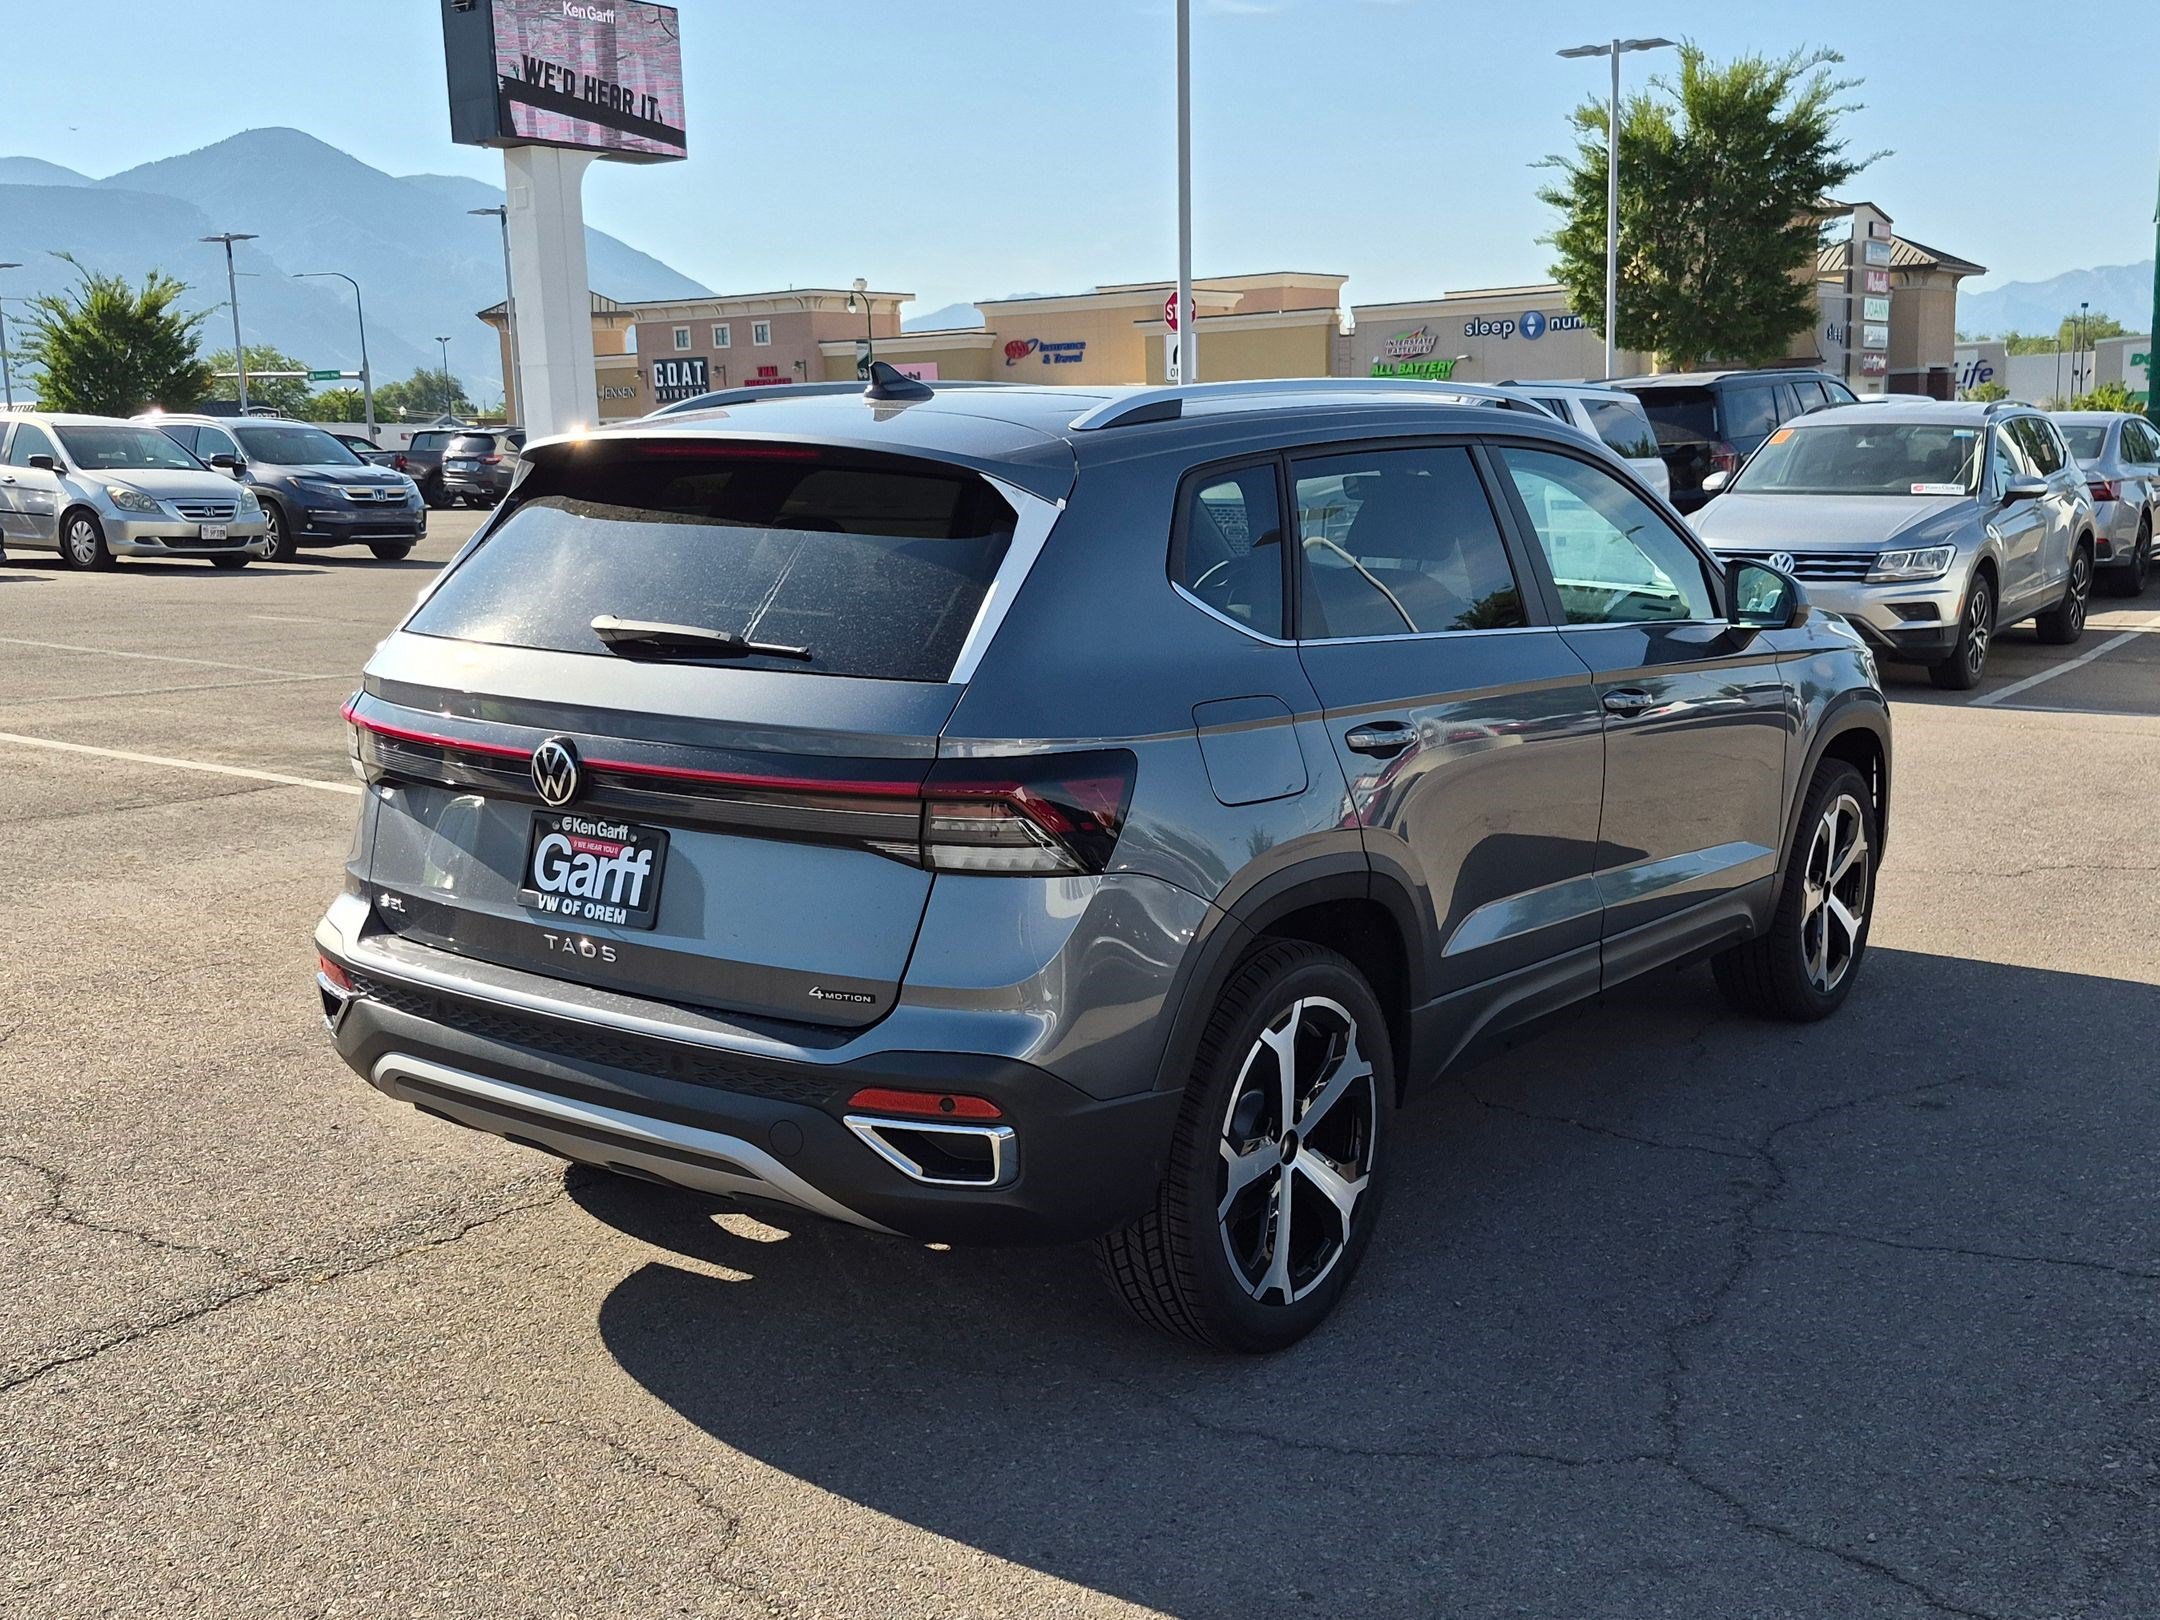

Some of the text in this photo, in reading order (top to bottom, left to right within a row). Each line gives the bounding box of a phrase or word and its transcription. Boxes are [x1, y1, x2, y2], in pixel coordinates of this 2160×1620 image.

[562, 1, 615, 24] Ken Garff
[522, 55, 576, 97] WE'D
[584, 74, 634, 115] HEAR
[1464, 317, 1515, 339] sleep
[1040, 341, 1086, 352] Insurance
[1053, 352, 1083, 364] Travel
[653, 361, 706, 387] G.O.A.T.
[1371, 361, 1456, 377] ALL BATTERY
[598, 385, 636, 401] JENSEN
[573, 818, 629, 841] Ken Garff
[534, 833, 653, 907] Garff
[538, 893, 627, 925] VW OF OREM
[543, 934, 618, 963] TAOS
[808, 986, 872, 1003] 4MOTION
